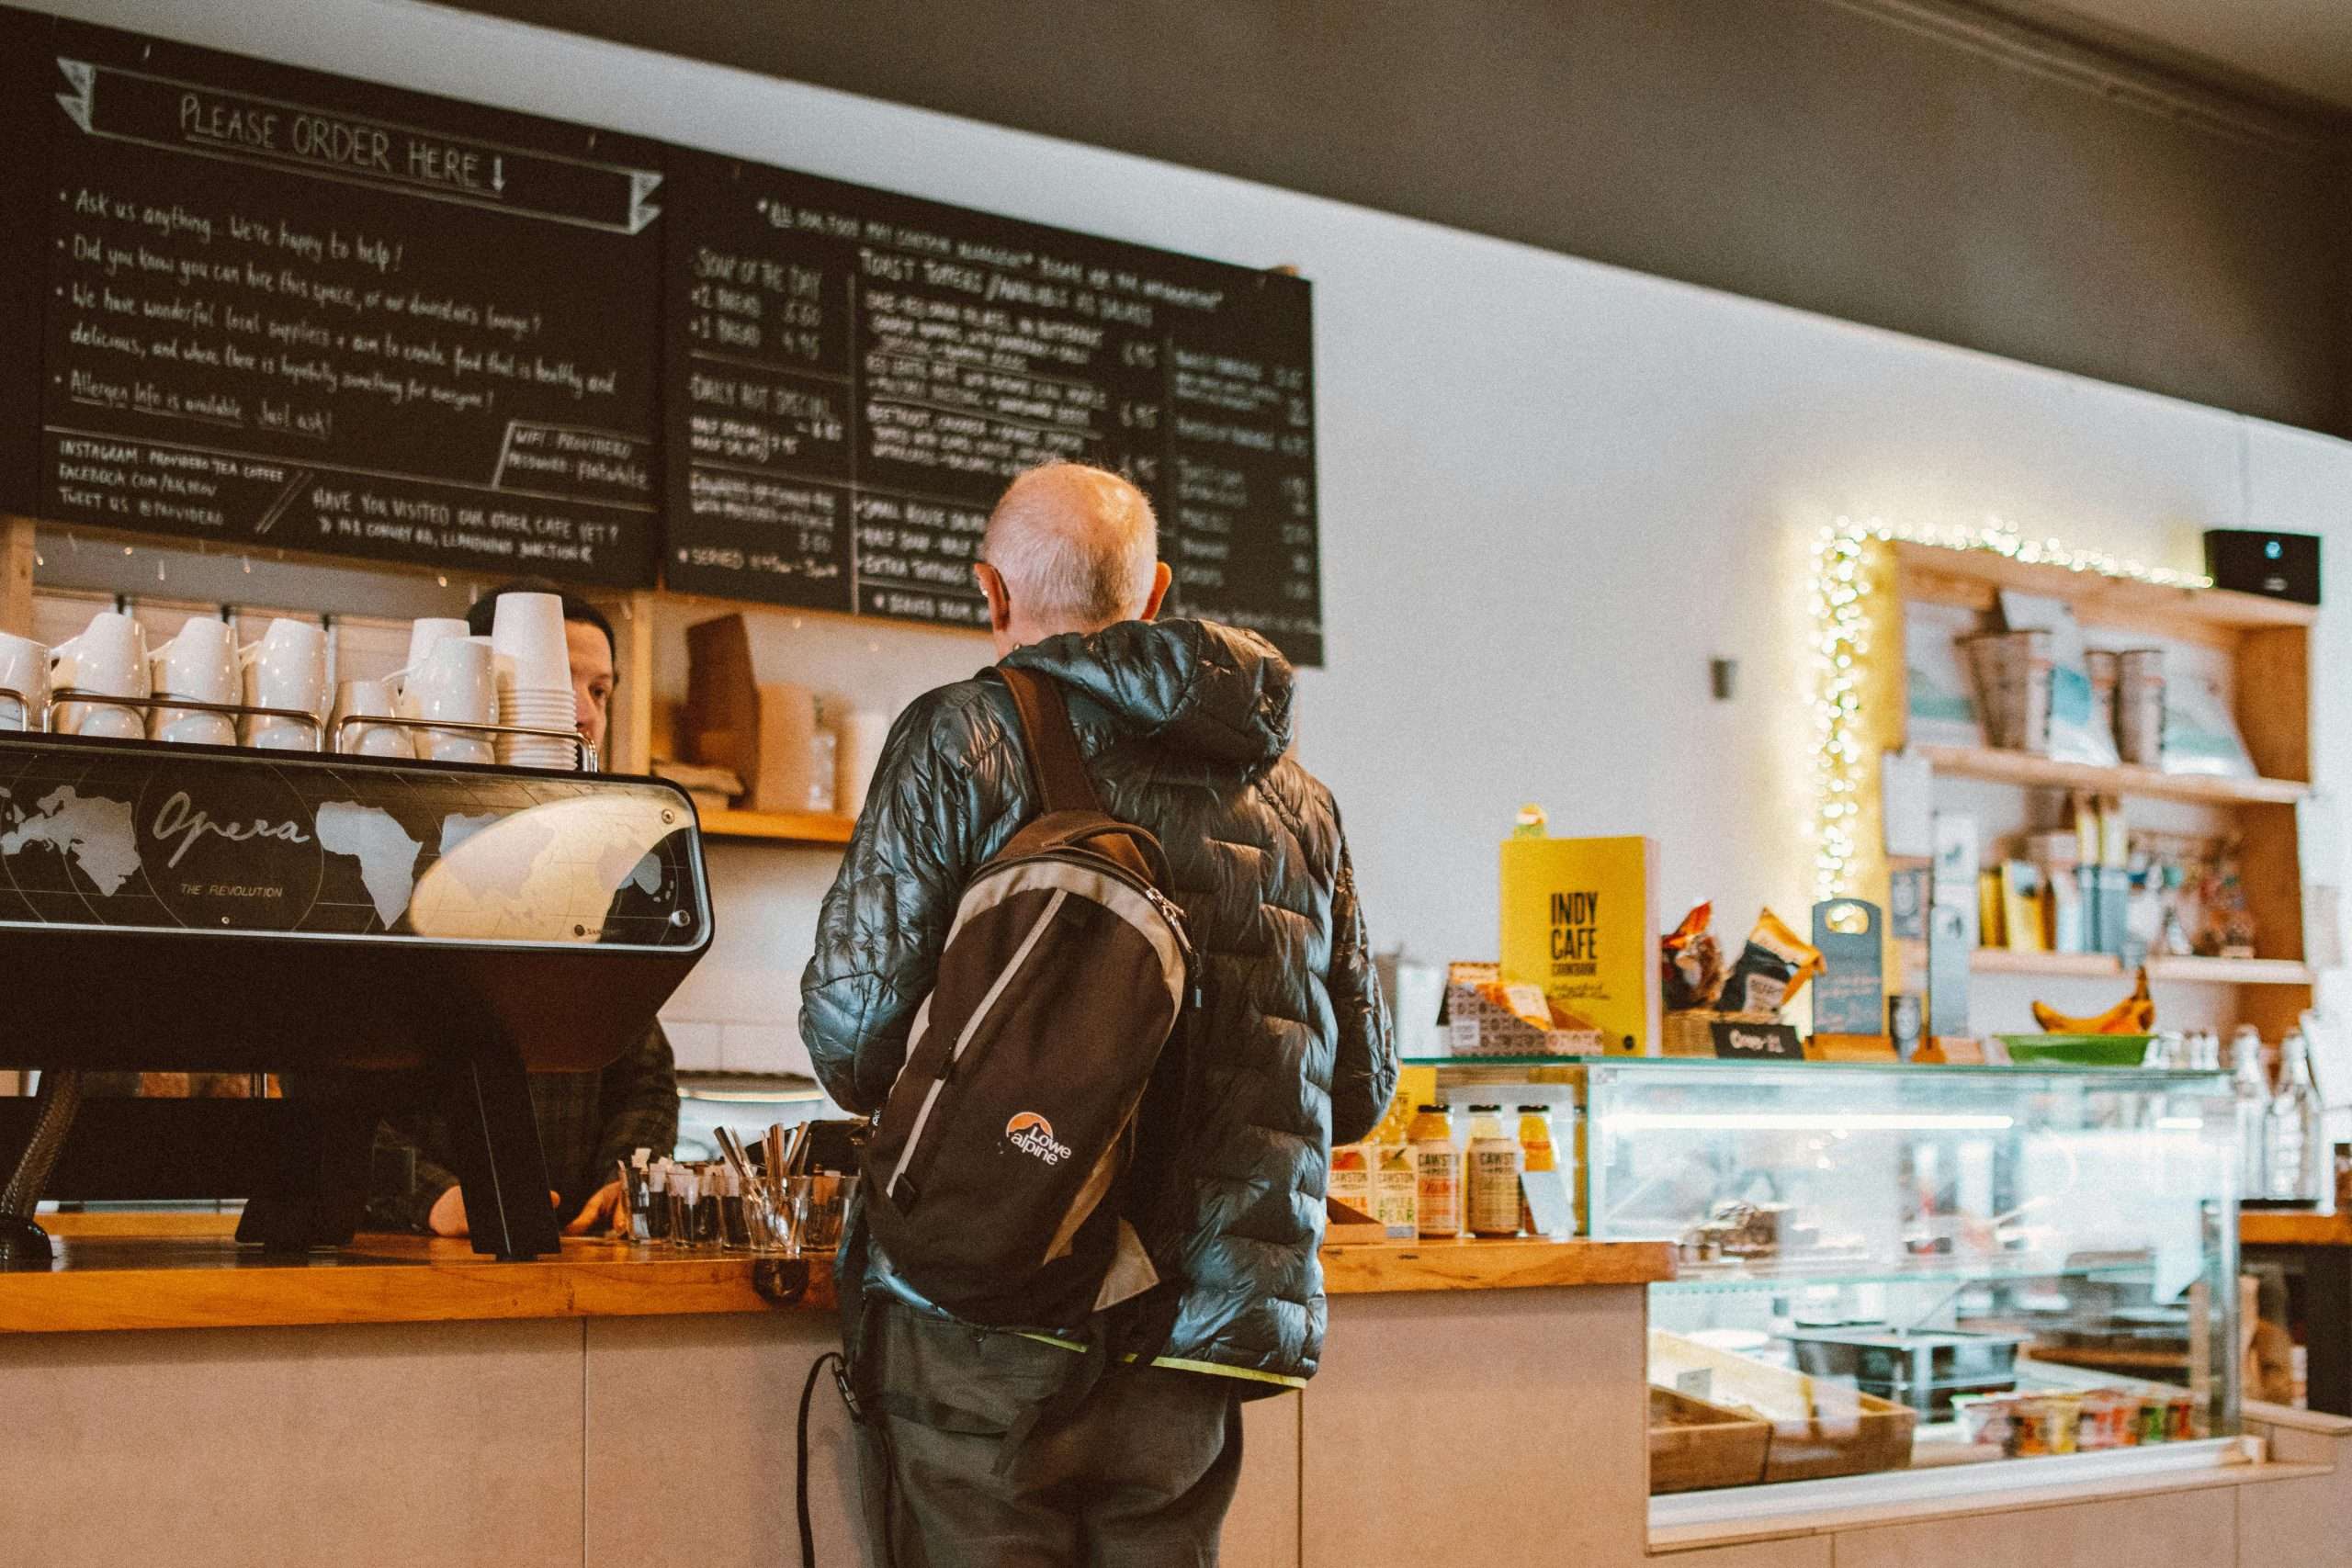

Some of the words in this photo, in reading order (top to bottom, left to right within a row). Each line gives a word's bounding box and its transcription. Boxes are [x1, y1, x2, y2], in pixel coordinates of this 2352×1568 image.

[180, 93, 277, 150] PLEASE
[292, 114, 391, 175] ORDER
[409, 140, 479, 189] HERE
[74, 187, 108, 218] Ask
[115, 202, 137, 221] us
[230, 213, 271, 246] We're
[278, 220, 322, 264] happy
[330, 230, 350, 258] to
[73, 233, 102, 262] Did
[106, 252, 134, 276] you
[138, 245, 175, 273] know
[179, 259, 209, 288] you
[213, 263, 240, 284] can
[246, 260, 276, 293] hire
[278, 269, 309, 299] this
[860, 248, 915, 282] TOAST
[73, 281, 96, 309] We
[103, 287, 138, 317] have
[143, 295, 215, 332] wonderful
[224, 303, 262, 334] local
[151, 338, 179, 360] and
[71, 369, 129, 409] Allergen
[311, 488, 353, 513] HAVE
[360, 491, 388, 516] YOU
[392, 497, 450, 526] VISITED
[458, 509, 484, 526] OUR
[490, 511, 531, 535] OTHER
[535, 515, 571, 539] CAFE
[153, 791, 310, 869] Opera
[181, 883, 202, 896] THE
[209, 885, 283, 897] REVOLUTION
[1550, 891, 1598, 926] INDY
[1550, 928, 1598, 960] CAFE
[1010, 1132, 1059, 1167] alpine
[1029, 1126, 1072, 1160] Lowe
